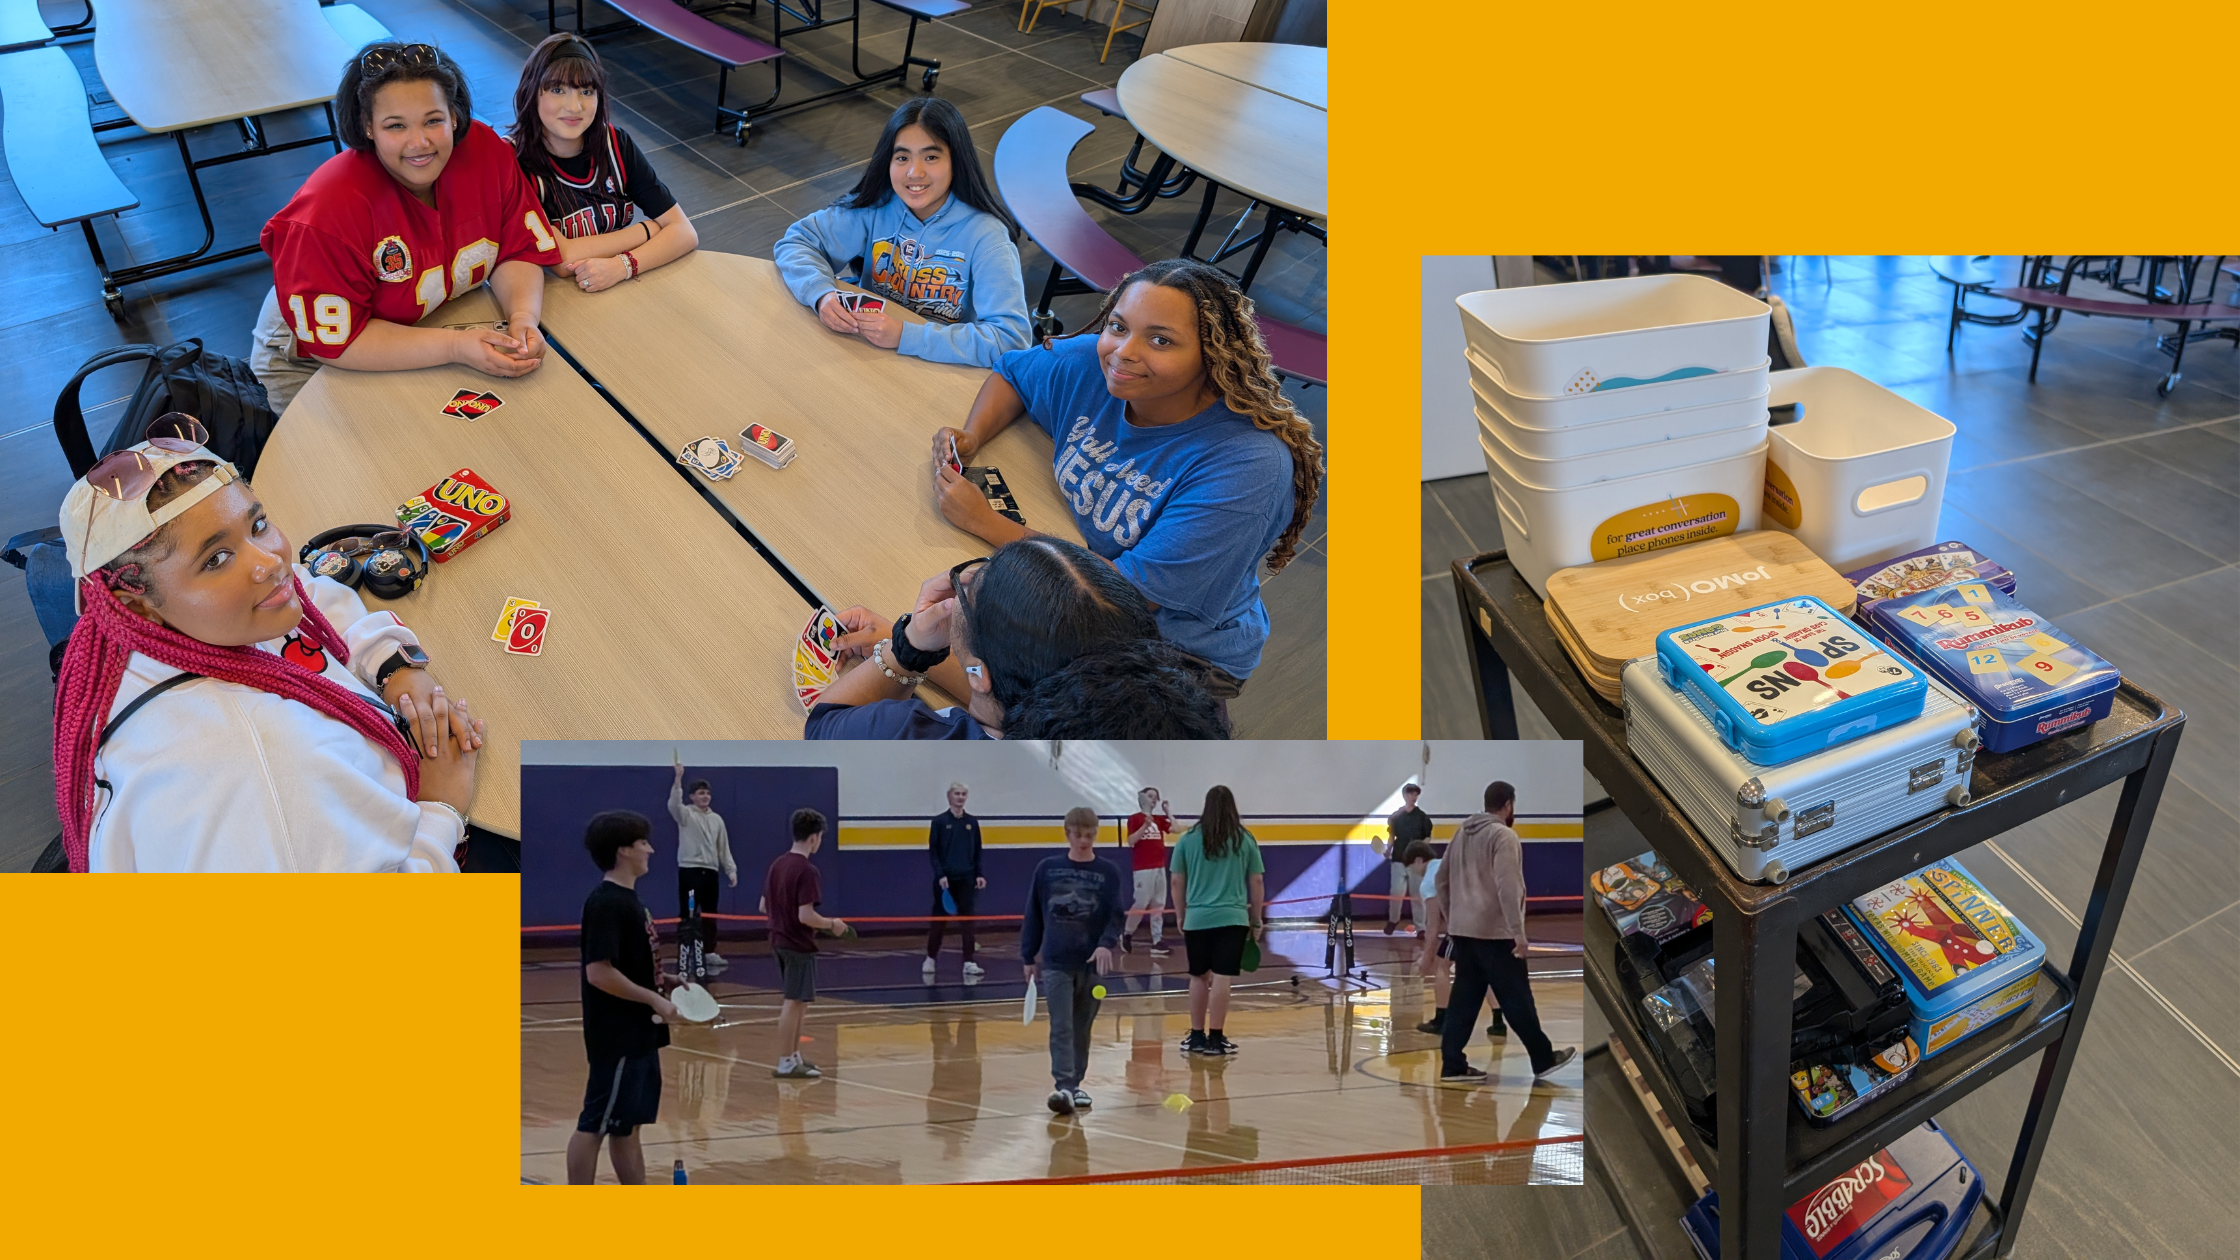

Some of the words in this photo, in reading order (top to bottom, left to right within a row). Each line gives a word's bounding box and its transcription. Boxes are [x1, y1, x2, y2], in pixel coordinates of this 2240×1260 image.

[385, 253, 404, 271] 35
[912, 299, 963, 319] Finals
[288, 294, 351, 345] 19
[468, 400, 492, 412] UNO
[757, 429, 772, 445] UNO
[433, 478, 506, 517] UNO
[1054, 445, 1151, 547] JESUS
[1607, 534, 1624, 544] for
[1625, 527, 1655, 543] great
[1658, 510, 1727, 533] conversation
[1617, 542, 1646, 558] place
[1648, 533, 1685, 550] phones
[1686, 525, 1718, 539] inside.
[1911, 571, 1944, 589] FIVE
[1968, 589, 1979, 598] 1
[1911, 610, 1927, 620] 7
[1937, 609, 1954, 619] 6
[1965, 610, 1980, 621] 5
[520, 623, 536, 640] 0
[1809, 621, 1828, 632] CARD
[1936, 617, 2034, 650] Rummikub
[1754, 630, 1780, 645] SPOON
[2036, 637, 2050, 647] 6
[531, 644, 538, 653] 0
[1971, 654, 1997, 666] 12
[2035, 661, 2053, 672] 9
[2036, 707, 2091, 734] Rummikub
[1896, 943, 1918, 969] DOMINO
[1911, 940, 1930, 959] SINCE
[1929, 956, 1943, 973] 1983
[1805, 1154, 1885, 1239] SCRABBLE
